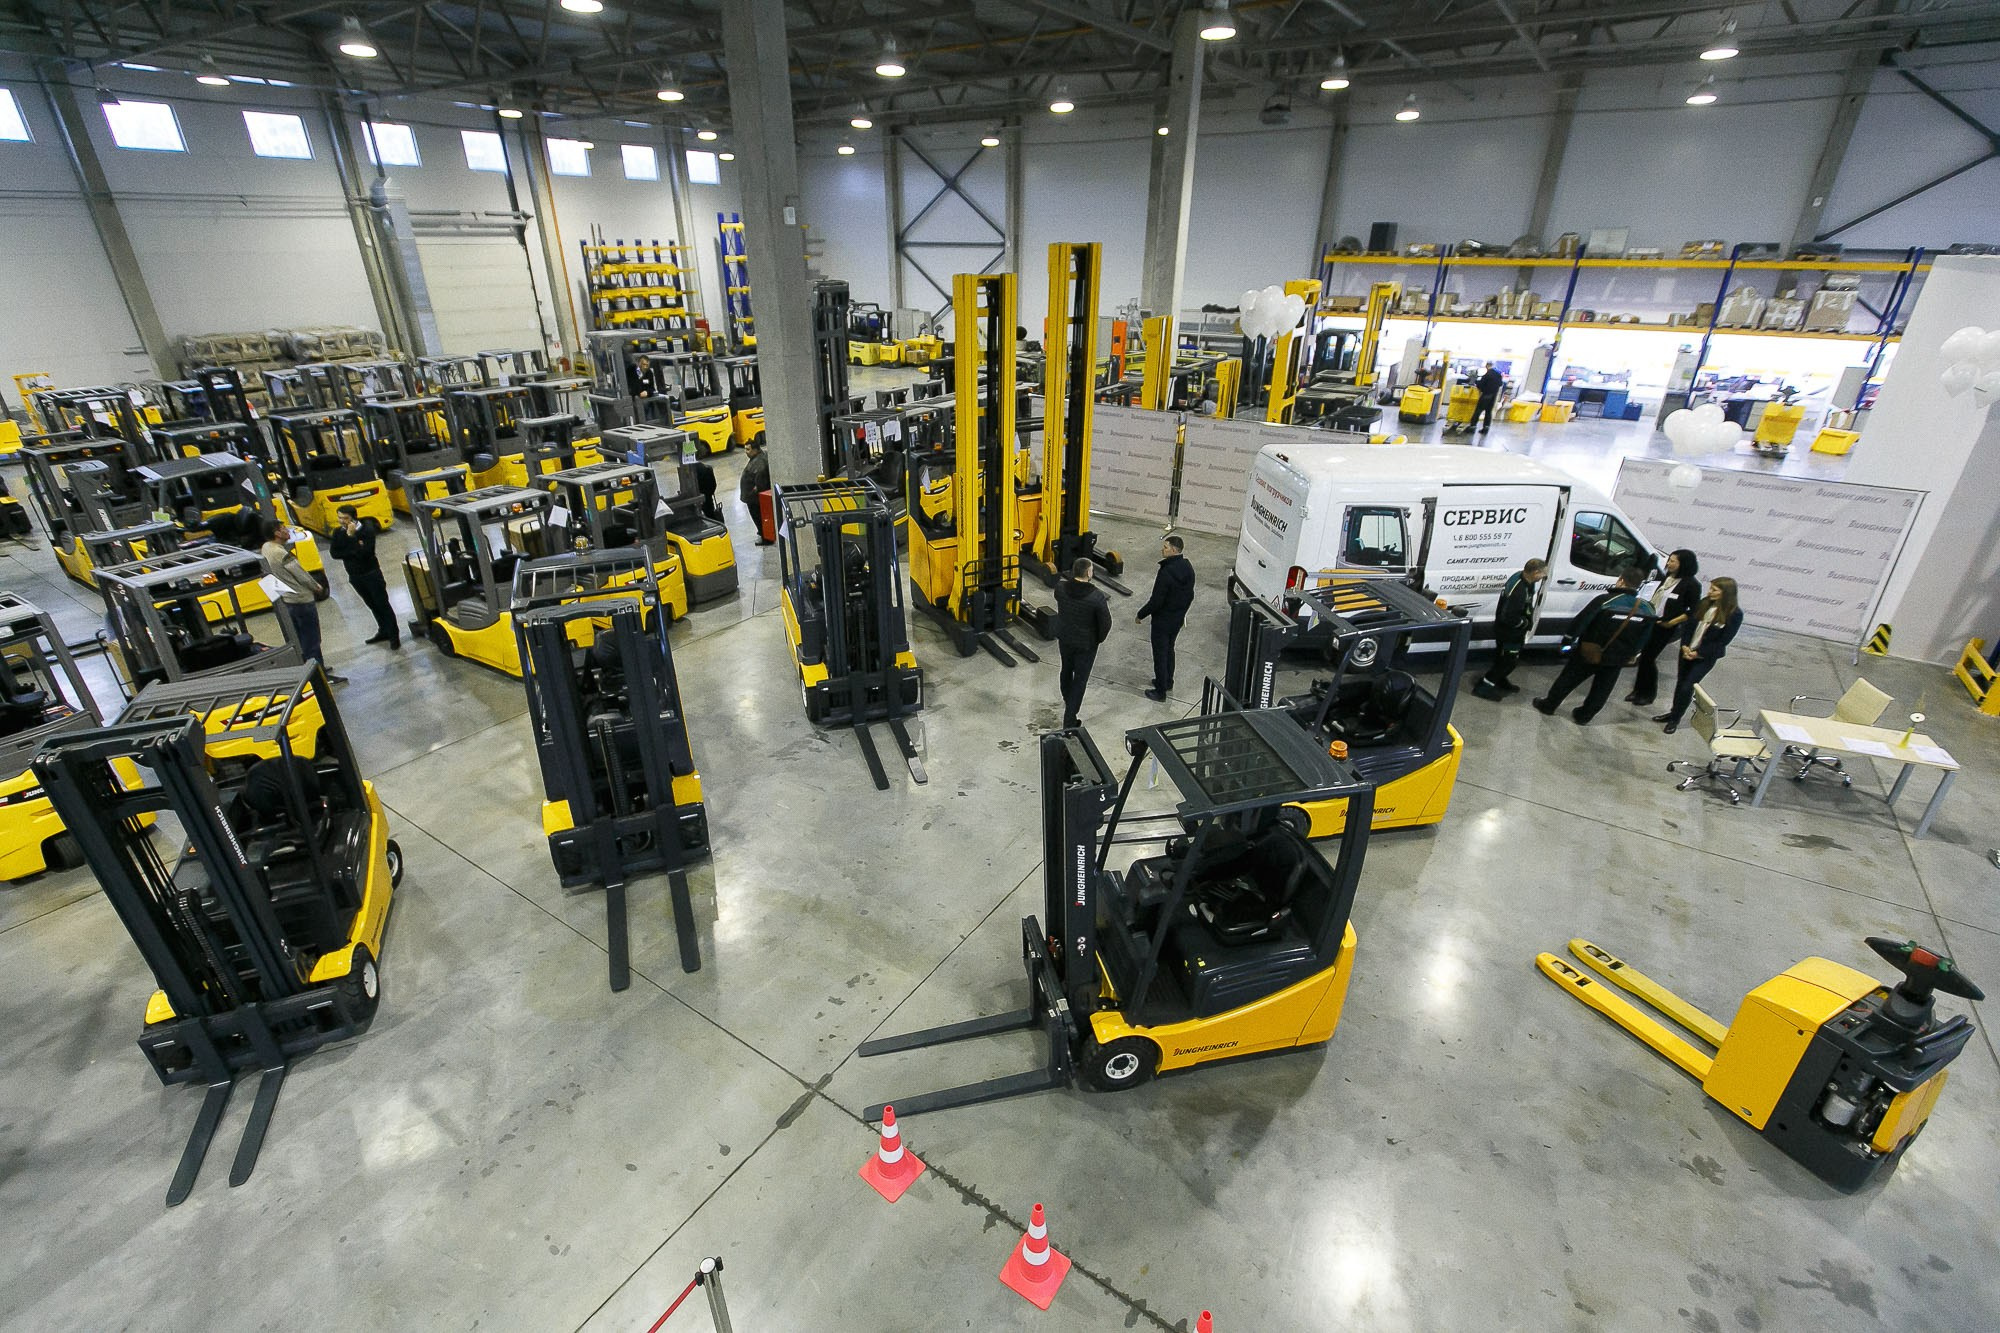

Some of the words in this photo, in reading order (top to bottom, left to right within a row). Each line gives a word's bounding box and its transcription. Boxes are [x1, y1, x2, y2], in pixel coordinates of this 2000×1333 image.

[1250, 494, 1288, 533] JUNGHEINRICH
[1443, 508, 1528, 526] СЕРВИС
[1464, 533, 1478, 541] 800
[1479, 532, 1492, 541] 555
[1493, 532, 1502, 540] 59
[1503, 532, 1513, 540] 77
[1441, 575, 1475, 583] ПРОДАЖА
[1481, 573, 1508, 582] АРЕНДА
[1440, 583, 1478, 591] СКЛАДСКОЙ
[214, 805, 248, 870] JUNGHEINRICH
[1075, 844, 1086, 906] JUNGHEINRICH
[1173, 1041, 1239, 1057] JUNGHEINRICH
